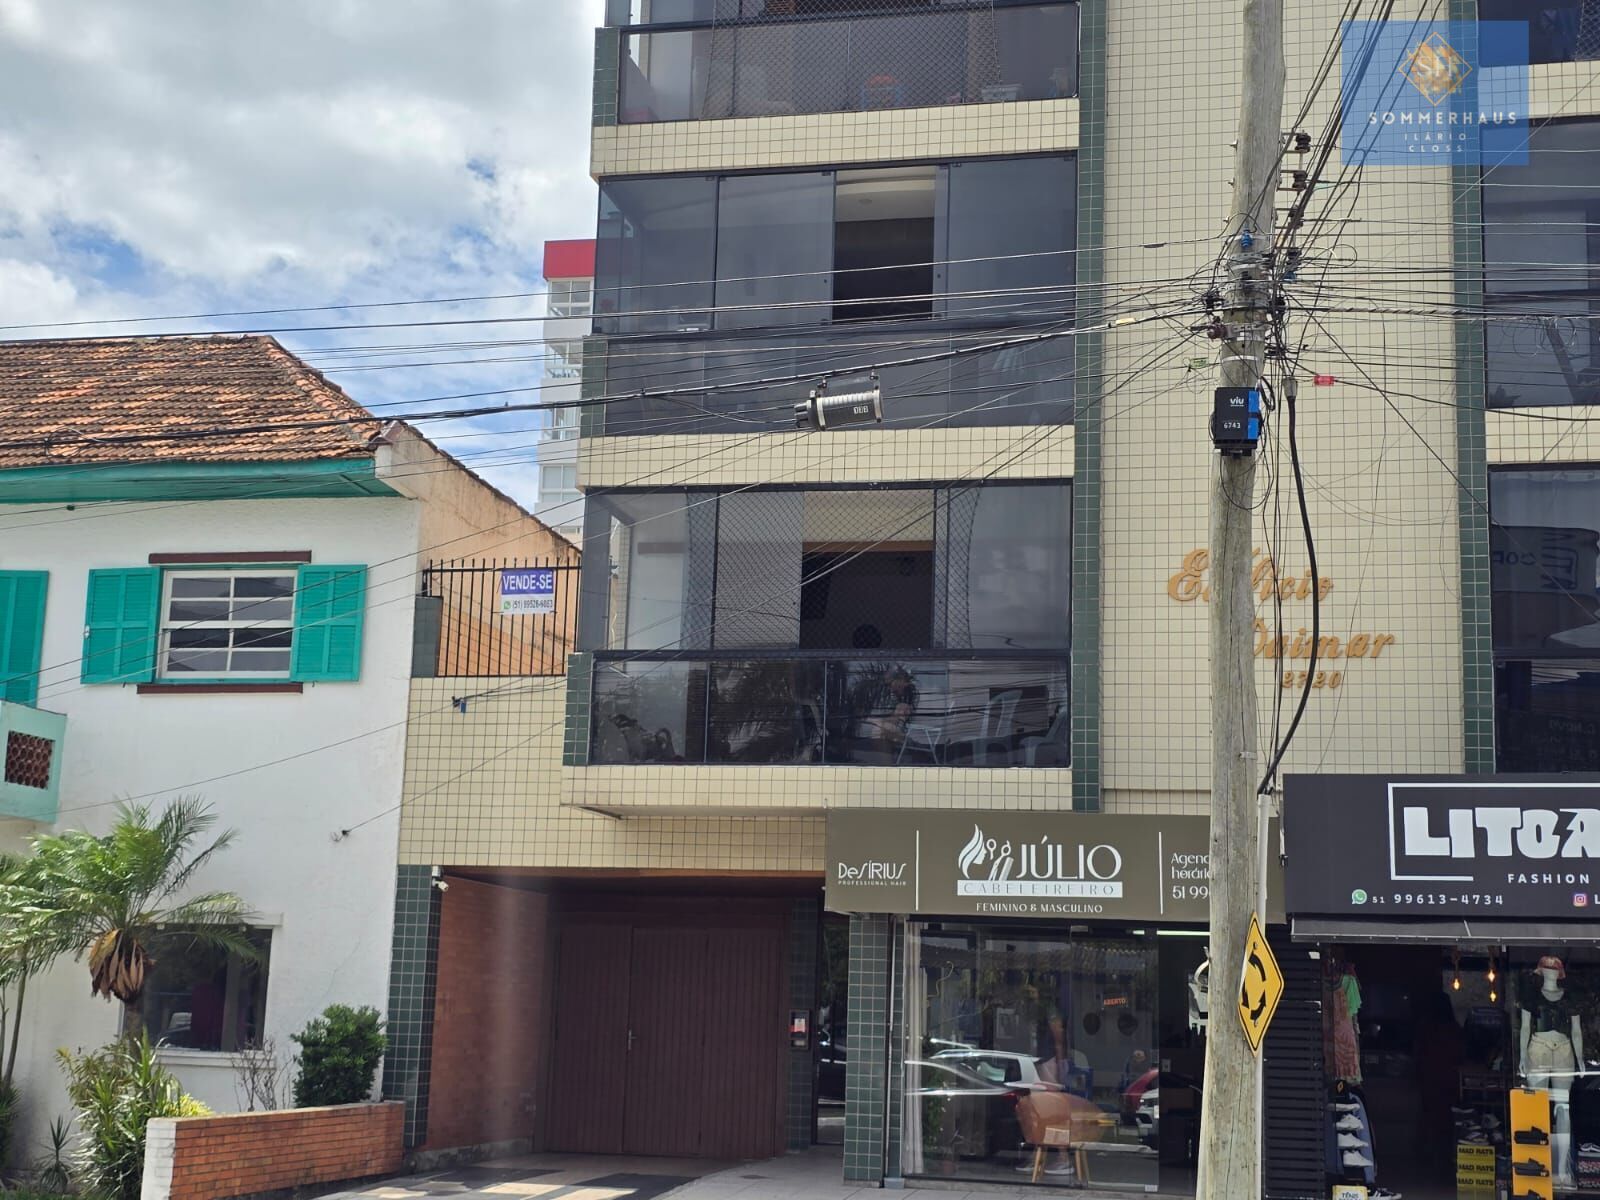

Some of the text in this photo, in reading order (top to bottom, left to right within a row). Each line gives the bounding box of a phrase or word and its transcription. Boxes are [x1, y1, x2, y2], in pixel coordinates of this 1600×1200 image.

[503, 574, 553, 590] VENDE-SE
[1016, 835, 1122, 880] JÚLIO
[1508, 873, 1590, 884] FASHION
[964, 883, 1115, 896] CABELEIREIRO
[1172, 885, 1186, 899] 51
[1372, 894, 1504, 905] 51 99613-4734
[976, 902, 1103, 913] FEMININO & MASCULINO
